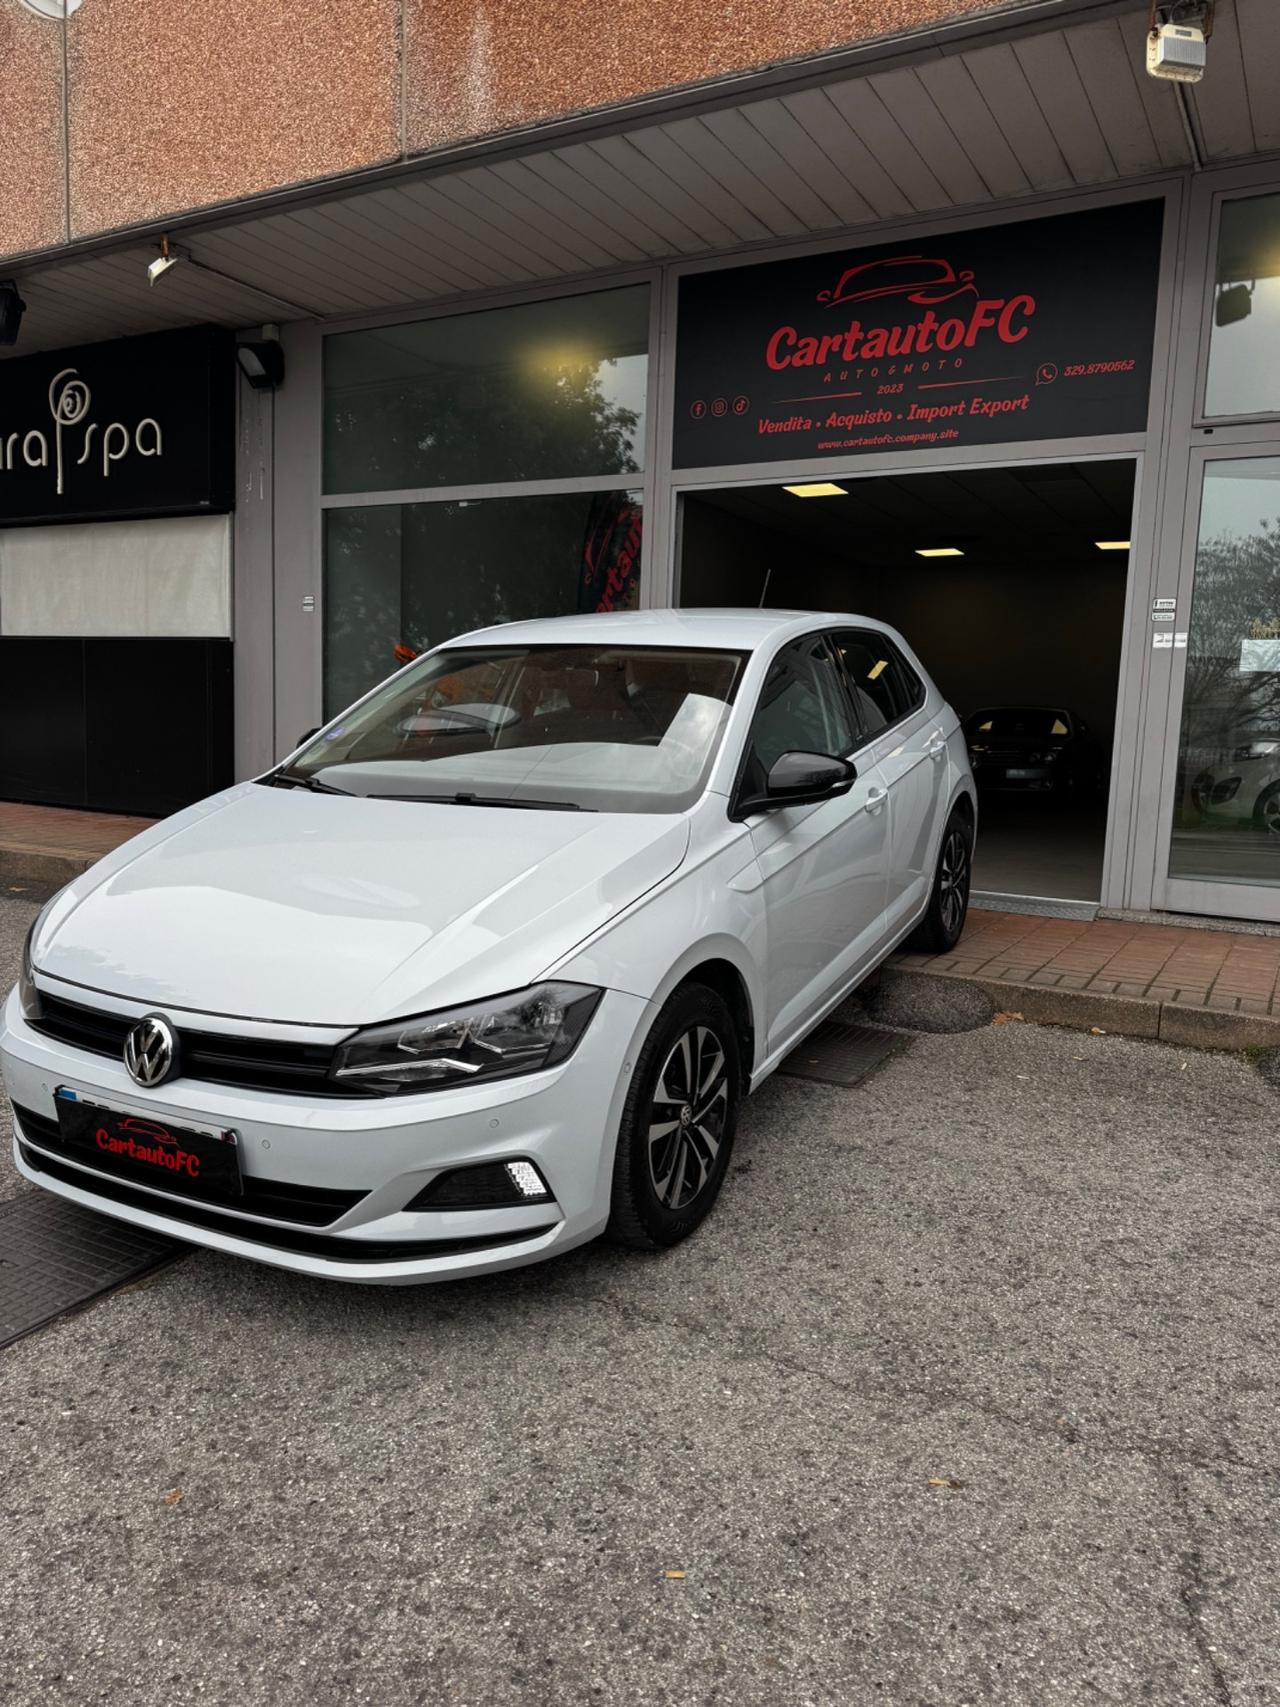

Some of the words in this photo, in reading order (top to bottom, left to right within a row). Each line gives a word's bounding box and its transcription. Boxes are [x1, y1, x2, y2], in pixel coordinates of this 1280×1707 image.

[766, 294, 1036, 371] CartautoFC
[1063, 358, 1135, 377] 329.8790562
[876, 383, 904, 396] 2023
[758, 415, 812, 434] Vendita
[825, 409, 892, 432] Acquisto
[907, 400, 966, 423] Import
[968, 393, 1030, 418] Export
[77, 417, 162, 477] spa
[816, 428, 960, 449] www.cartautofc.company.site
[95, 1128, 201, 1177] CartautoFC
